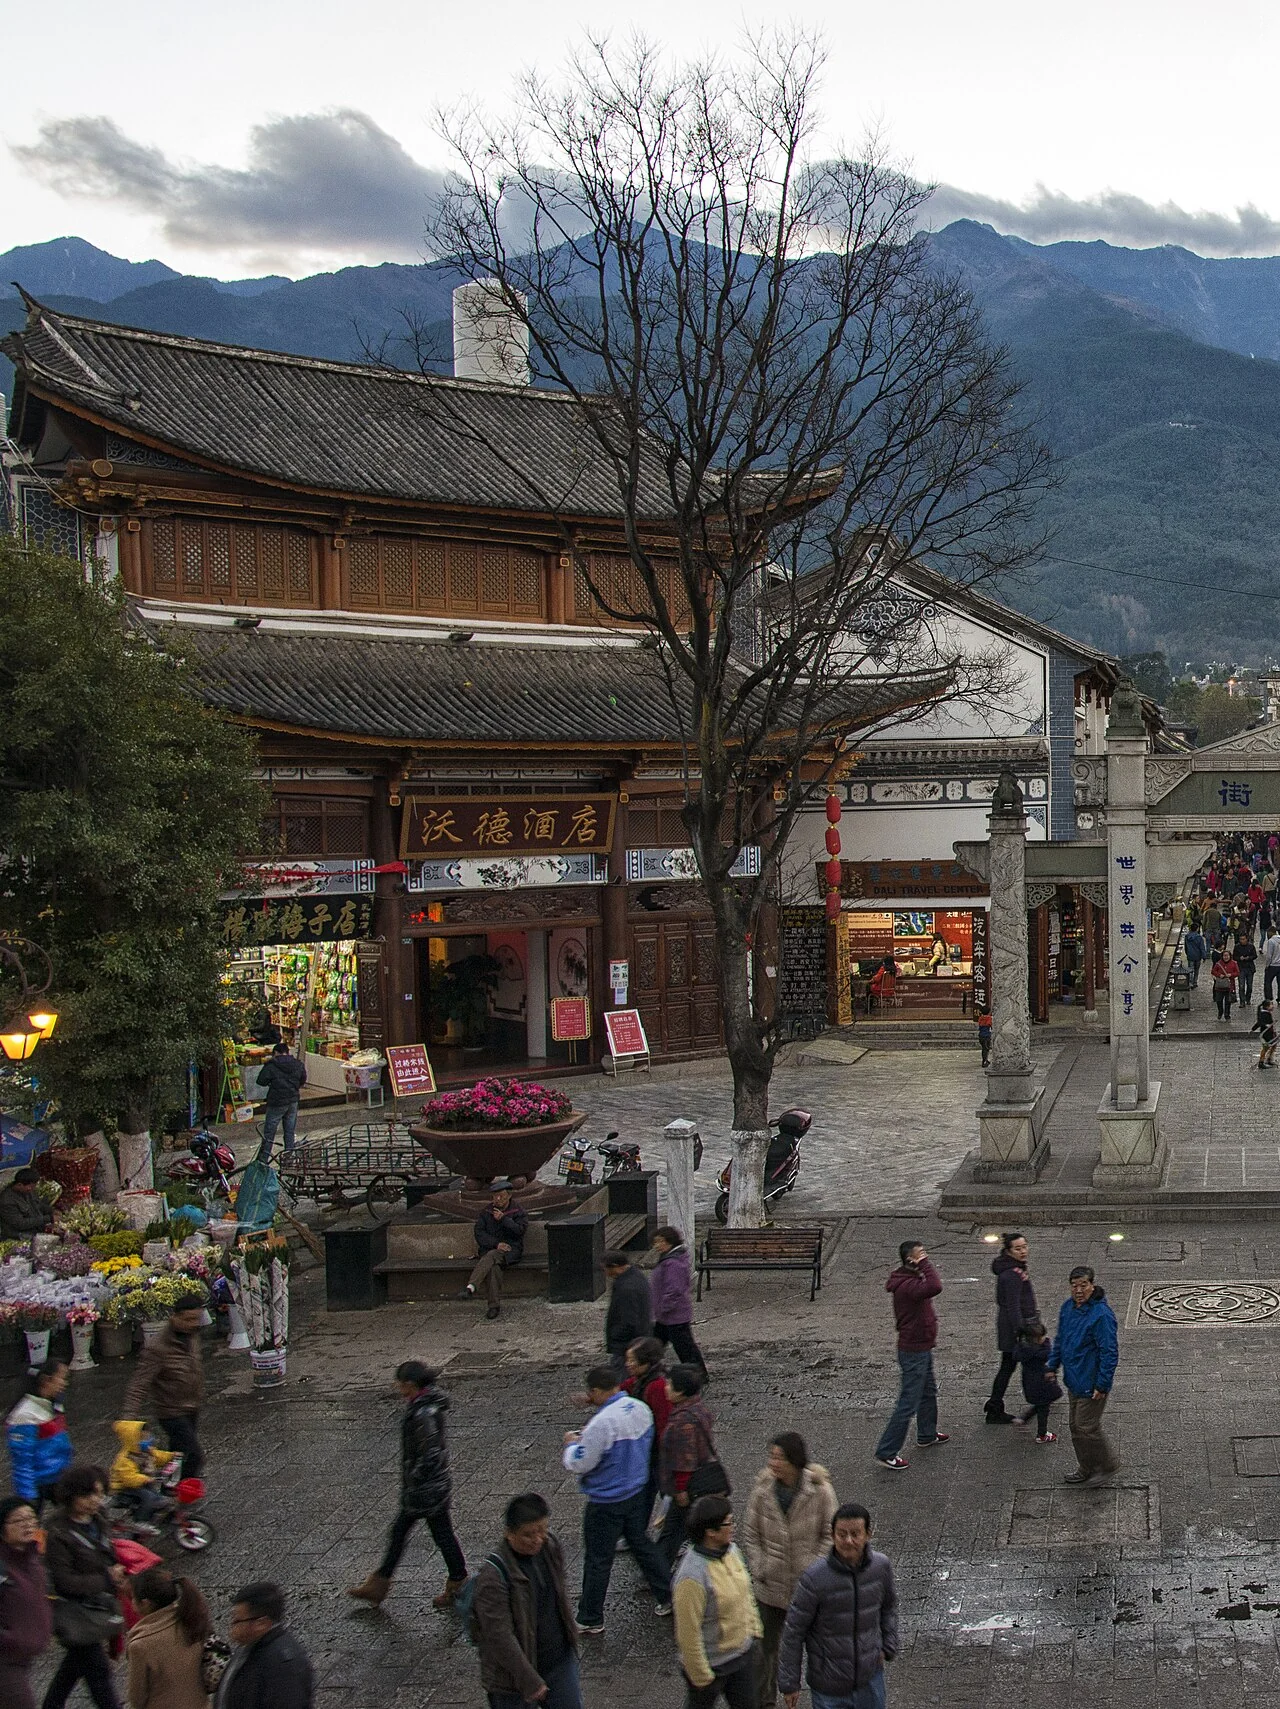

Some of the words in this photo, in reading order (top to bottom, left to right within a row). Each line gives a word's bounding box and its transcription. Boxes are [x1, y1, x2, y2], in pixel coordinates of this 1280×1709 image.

[421, 804, 597, 847] 沃德酒店
[874, 886, 896, 895] DALI
[902, 885, 938, 895] TRAVEL
[944, 885, 984, 894] CENTER
[1115, 856, 1139, 1016] 世界共分享
[395, 1058, 425, 1068] 过桥米线
[397, 1067, 428, 1077] 由此进入
